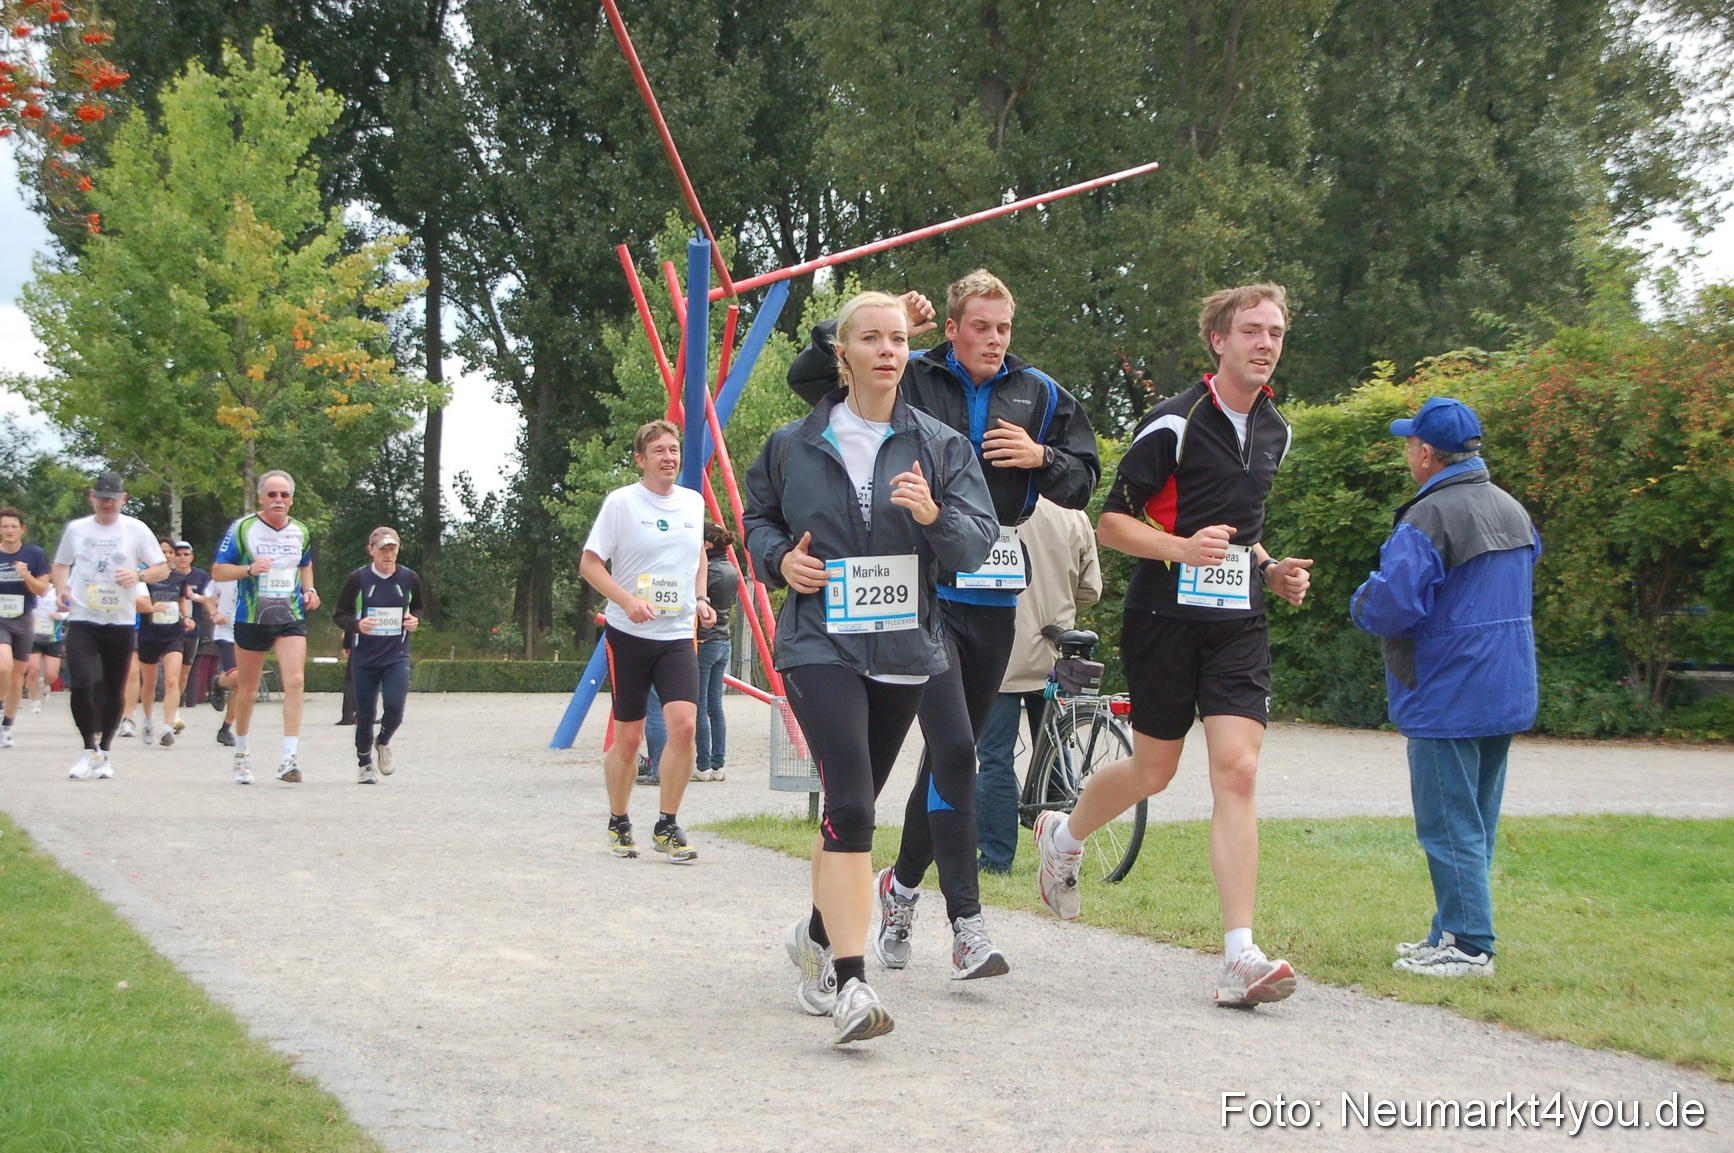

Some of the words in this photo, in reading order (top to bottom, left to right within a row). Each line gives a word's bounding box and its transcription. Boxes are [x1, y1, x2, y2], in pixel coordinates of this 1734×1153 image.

[1226, 553, 1240, 563] eas
[852, 564, 890, 578] Marika
[1203, 567, 1244, 586] 2955
[269, 580, 291, 588] 3230
[652, 578, 678, 588] Andreas
[655, 591, 678, 603] 953
[833, 587, 839, 597] B
[855, 584, 909, 606] 2289
[101, 597, 120, 605] 535
[378, 618, 399, 626] 3006
[884, 617, 917, 627] PFLEIDERER
